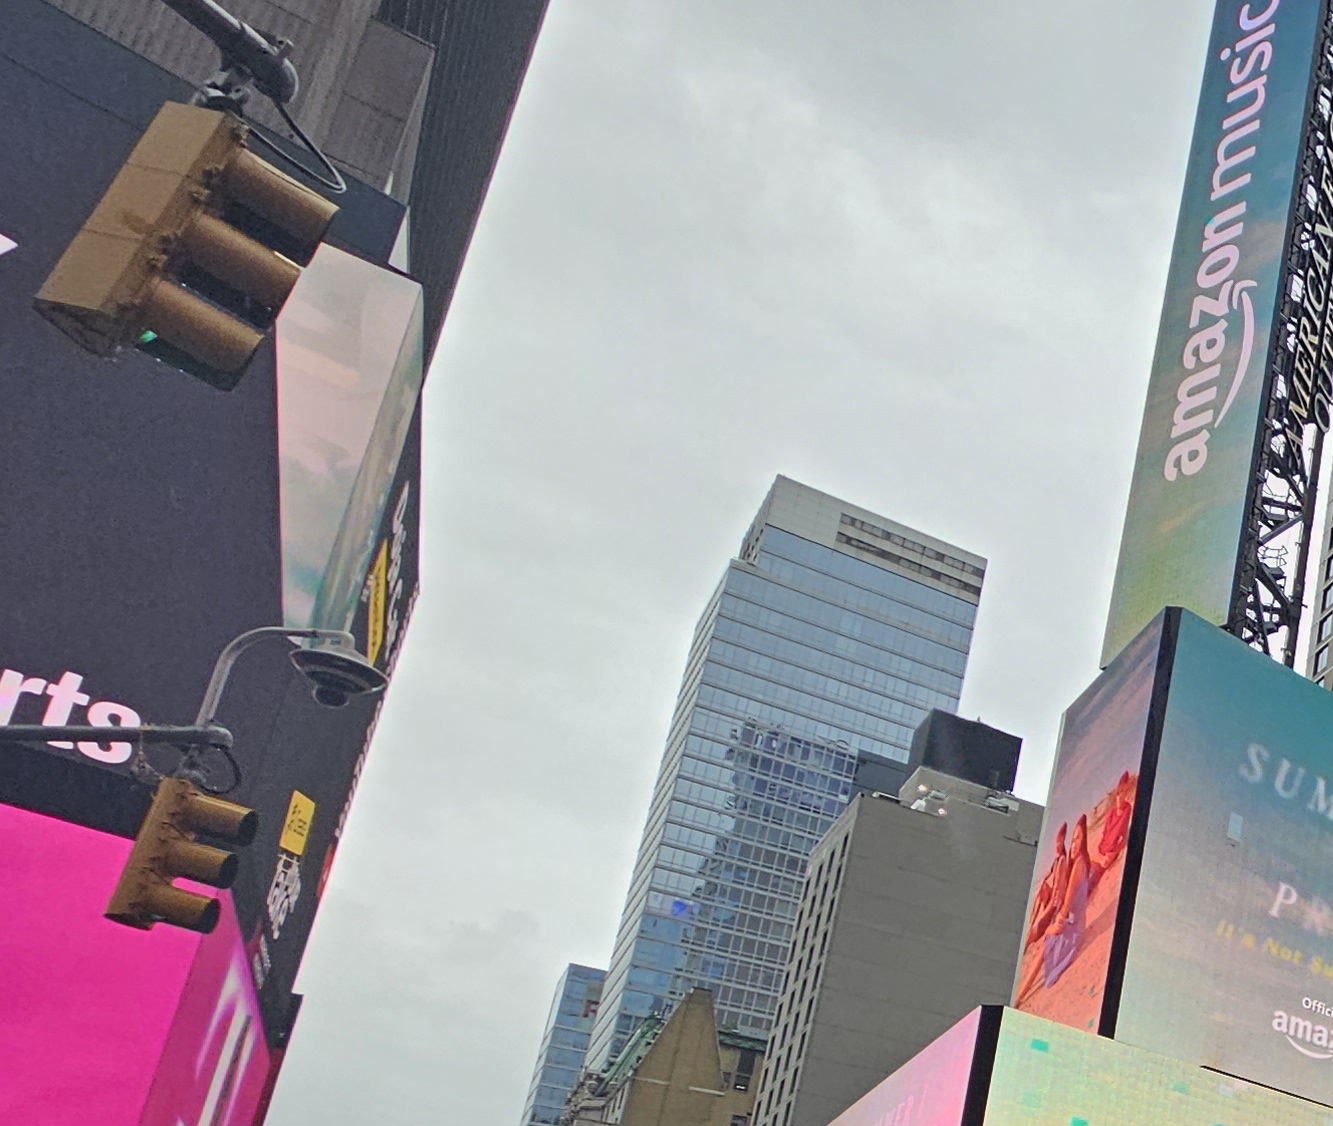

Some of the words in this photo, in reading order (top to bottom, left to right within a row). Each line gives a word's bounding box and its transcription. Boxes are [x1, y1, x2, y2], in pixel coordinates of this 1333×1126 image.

[1164, 200, 1247, 483] amazon
[1210, 0, 1280, 201] music
[1265, 936, 1304, 966] Not
